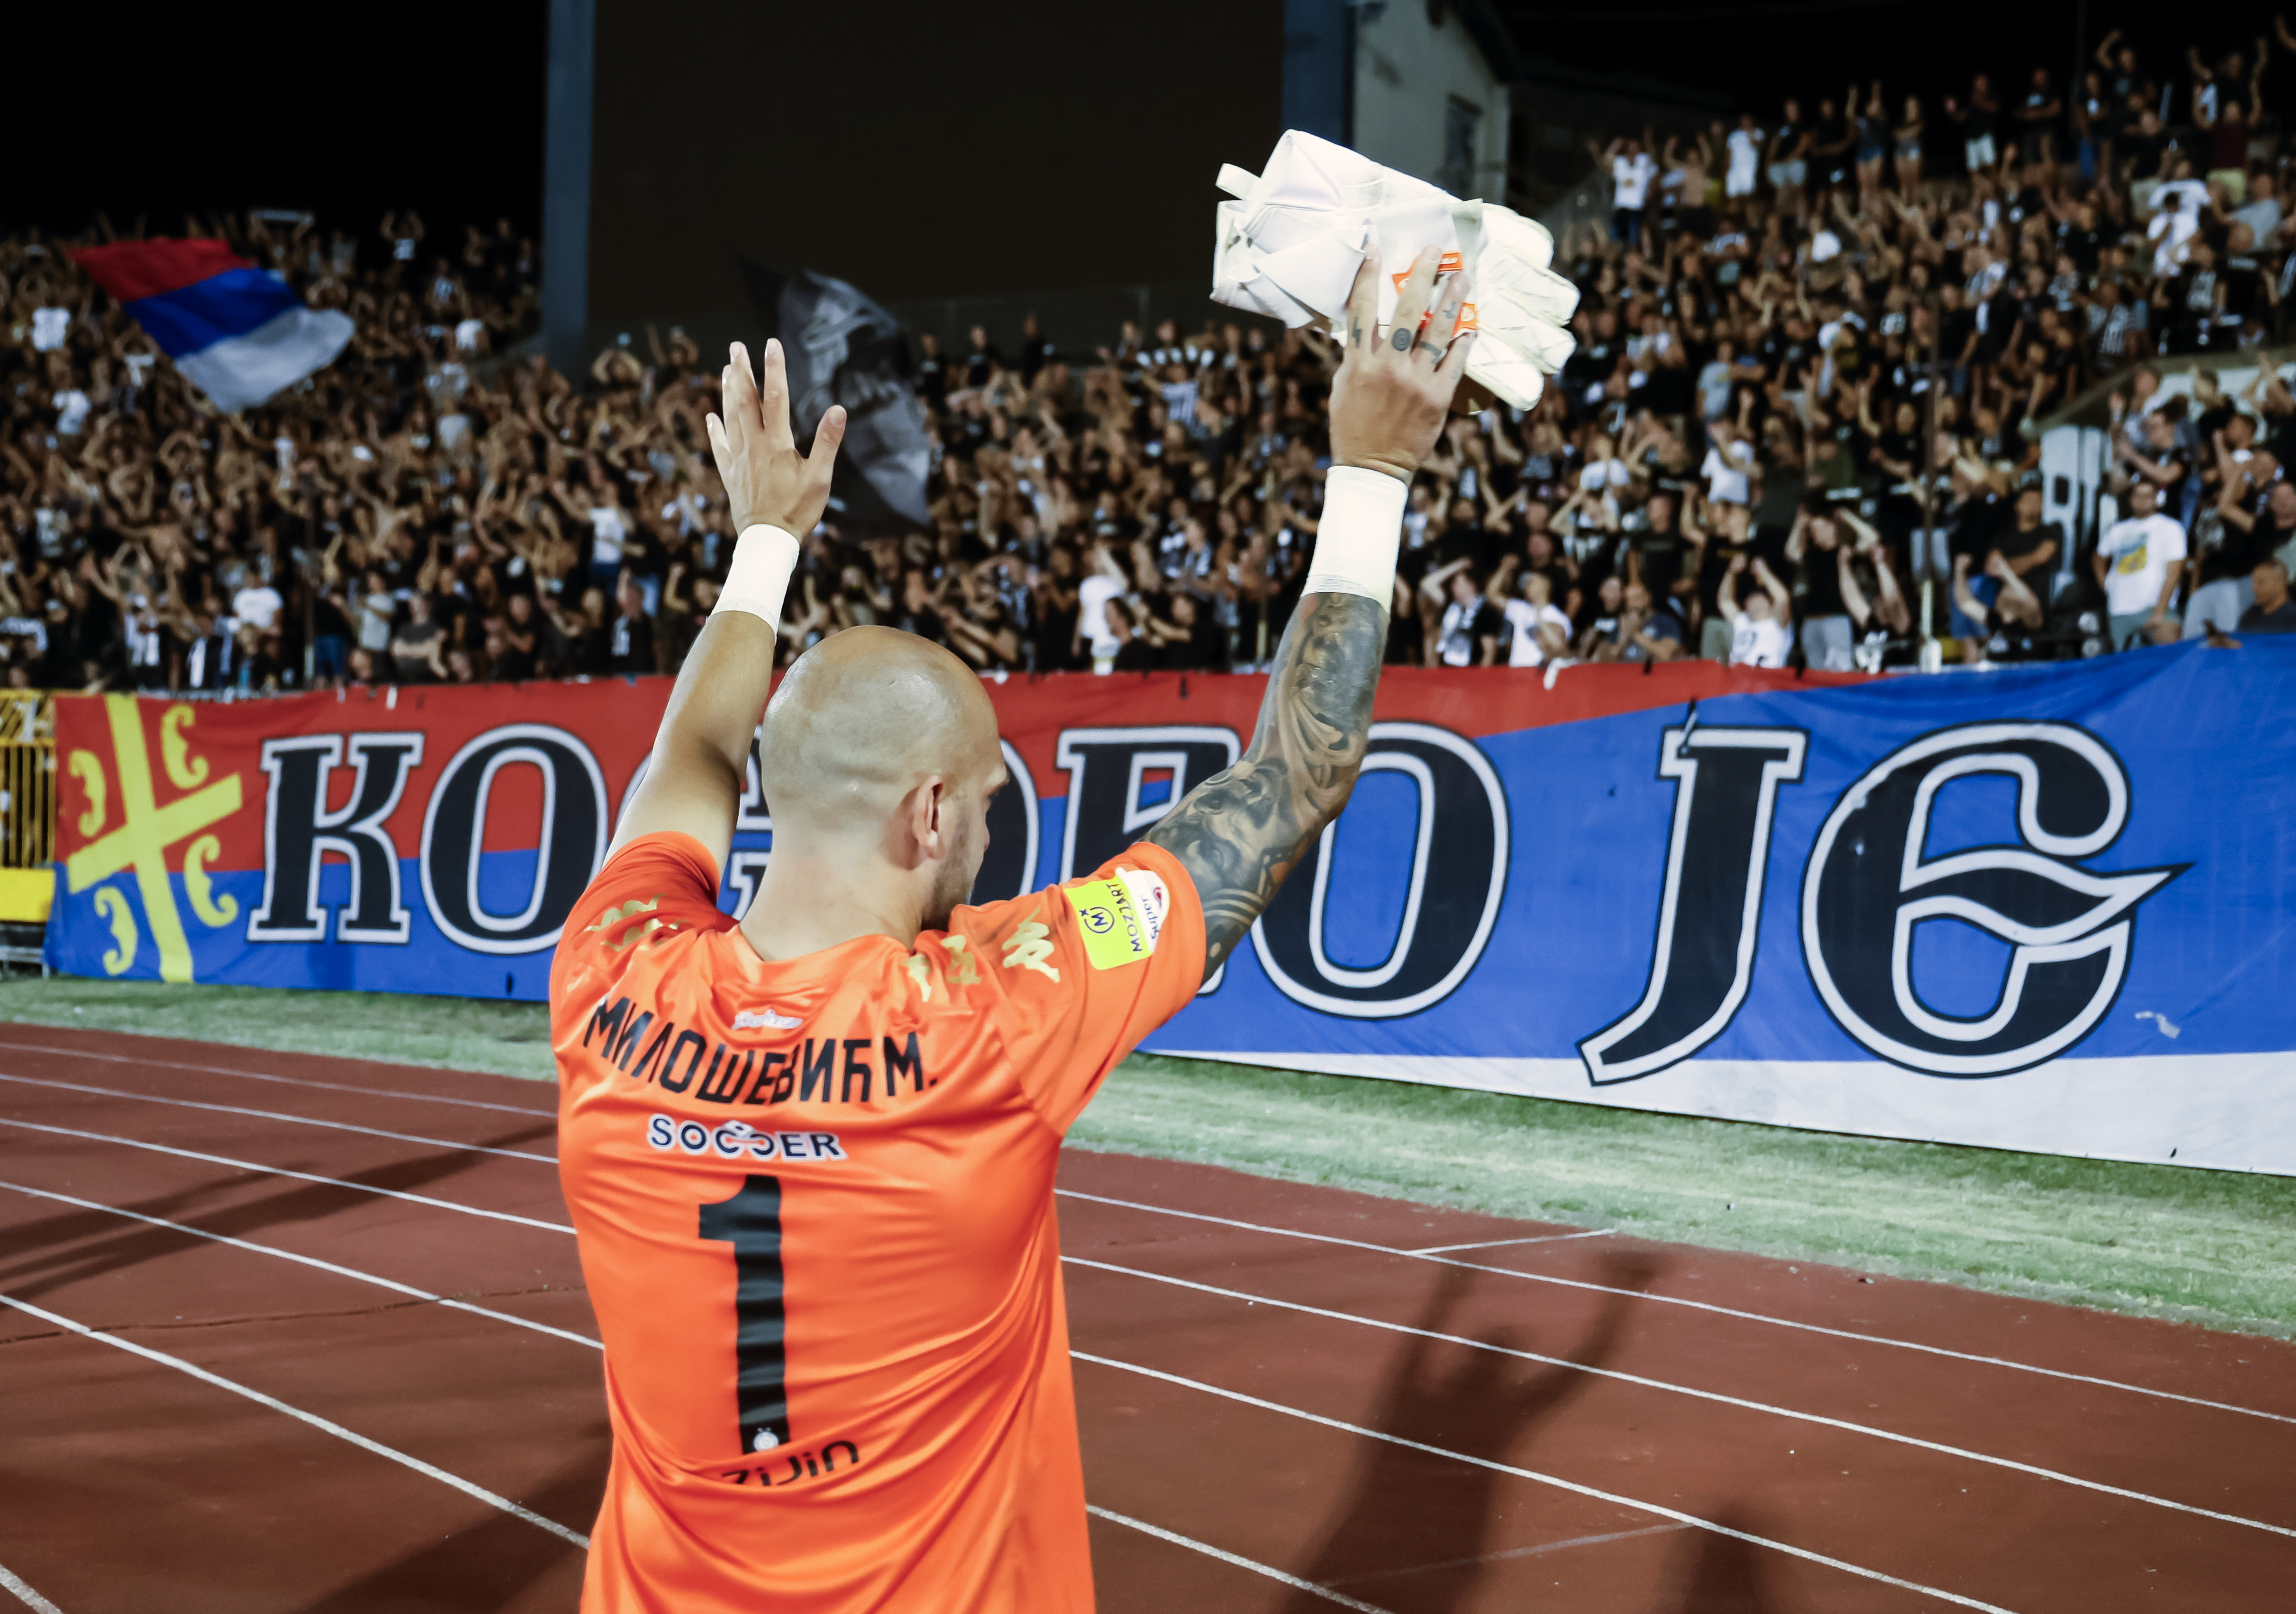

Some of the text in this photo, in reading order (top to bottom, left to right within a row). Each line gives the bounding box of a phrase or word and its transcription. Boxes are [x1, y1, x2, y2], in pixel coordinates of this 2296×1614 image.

[1106, 883, 1143, 952] MOZZART
[650, 1116, 842, 1158] SOCCER
[698, 1173, 790, 1455] 1
